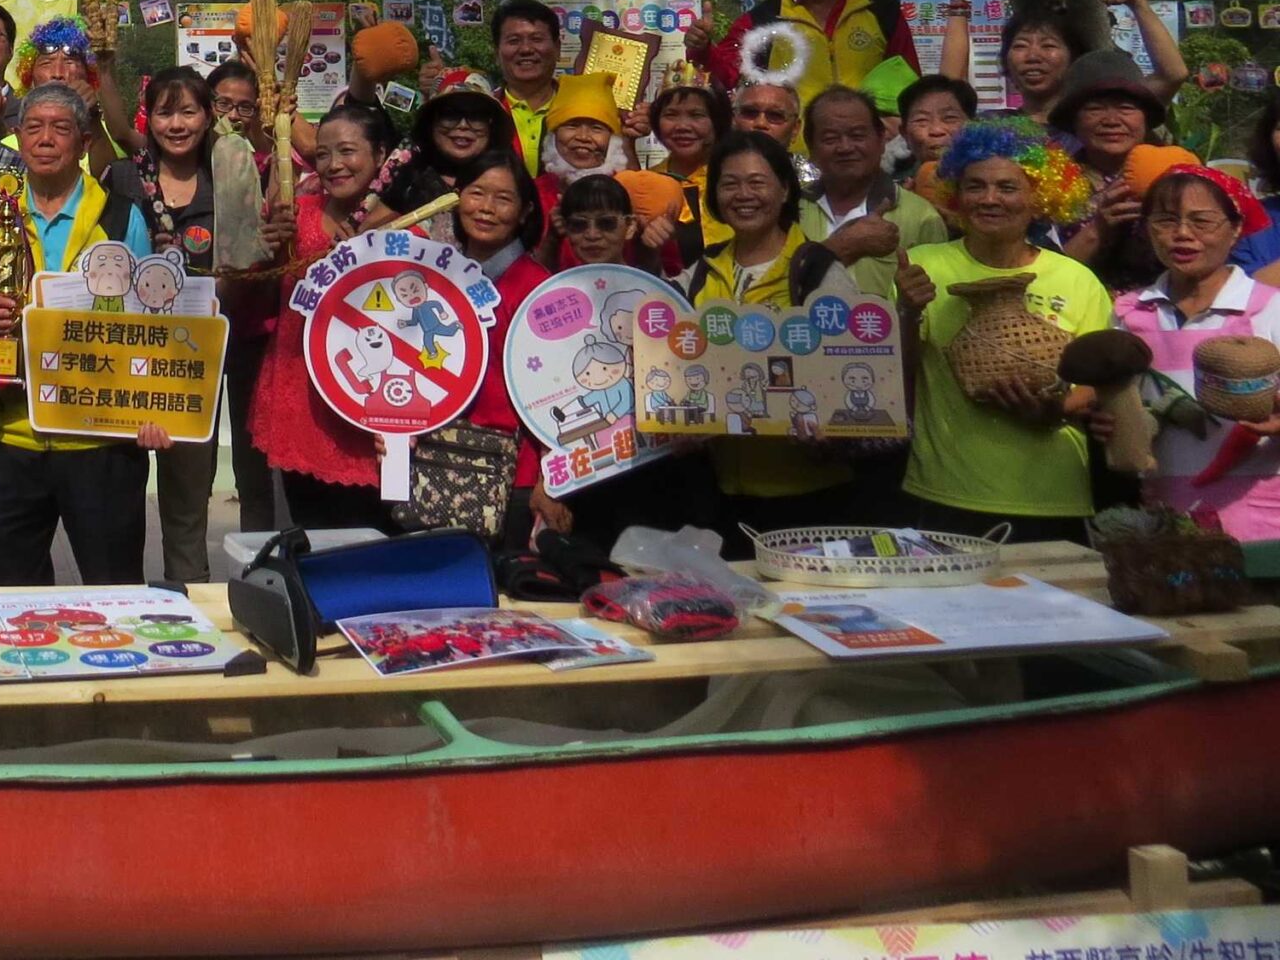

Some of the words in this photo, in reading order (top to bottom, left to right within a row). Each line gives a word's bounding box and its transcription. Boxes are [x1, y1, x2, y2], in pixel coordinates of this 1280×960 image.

[63, 320, 169, 347] 提供資訊時
[644, 303, 883, 356] 長者賦能再就業
[61, 353, 115, 374] 字體大
[150, 358, 206, 381] 說話慢
[58, 385, 205, 414] 配合長輩慣用語言
